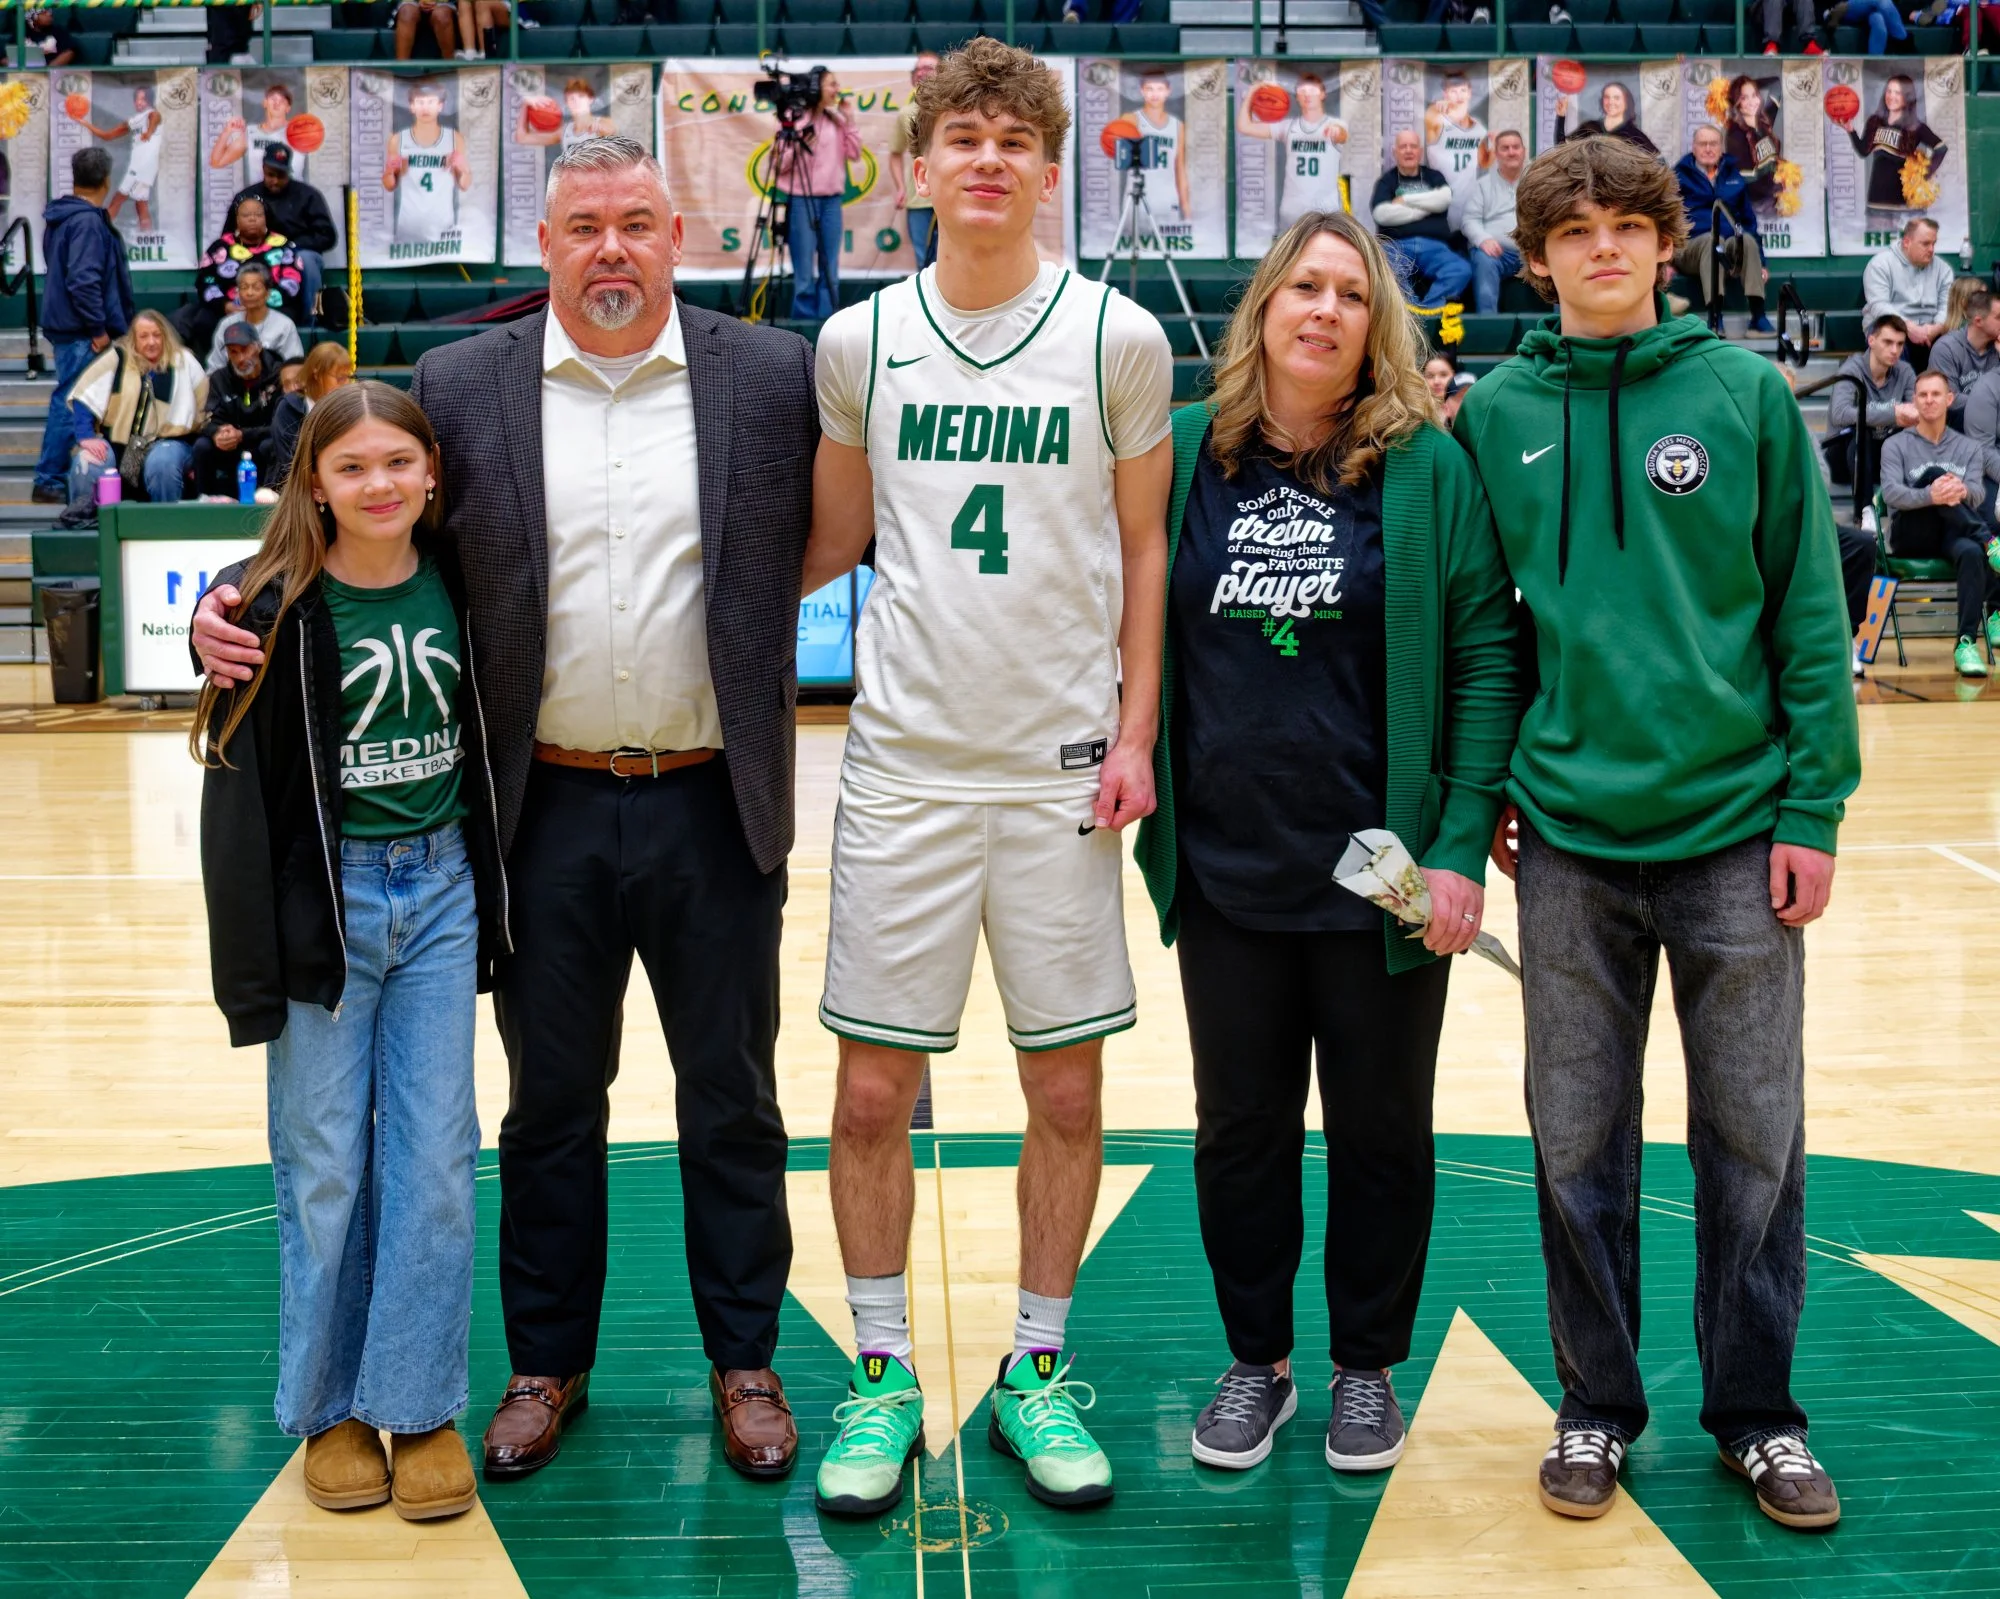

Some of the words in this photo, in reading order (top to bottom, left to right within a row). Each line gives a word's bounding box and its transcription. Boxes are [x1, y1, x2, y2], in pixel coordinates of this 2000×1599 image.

[358, 97, 385, 146] BEES
[1291, 140, 1326, 153] MEDINA
[1445, 137, 1481, 150] MEDINA
[408, 155, 447, 168] MEDINA
[1296, 157, 1319, 176] 20
[358, 152, 385, 228] MEDINA
[420, 172, 434, 192] 4
[511, 150, 537, 228] MEDINA
[1240, 143, 1265, 220] MEDINA
[1831, 142, 1857, 219] MEDINA
[389, 239, 463, 260] HARUBIN
[897, 403, 1070, 465] MEDINA
[1648, 449, 1659, 478] MEDINA
[1657, 437, 1675, 450] BEES
[1675, 437, 1698, 450] MEN'S
[1695, 448, 1707, 477] SOCCER
[1237, 488, 1278, 513] SOME
[1279, 486, 1336, 519] PEOPLE
[1266, 499, 1305, 521] only
[950, 484, 1009, 575] 4
[1227, 513, 1336, 546] dream
[1227, 541, 1243, 553] of
[1242, 544, 1296, 560] meeting
[1297, 542, 1330, 556] their
[1267, 557, 1344, 572] FAVORITE
[1209, 560, 1342, 618] player
[1223, 608, 1228, 618] I
[1229, 608, 1267, 618] RAISED
[1313, 609, 1343, 620] MINE
[1261, 617, 1300, 657] #4
[1095, 746, 1104, 758] M
